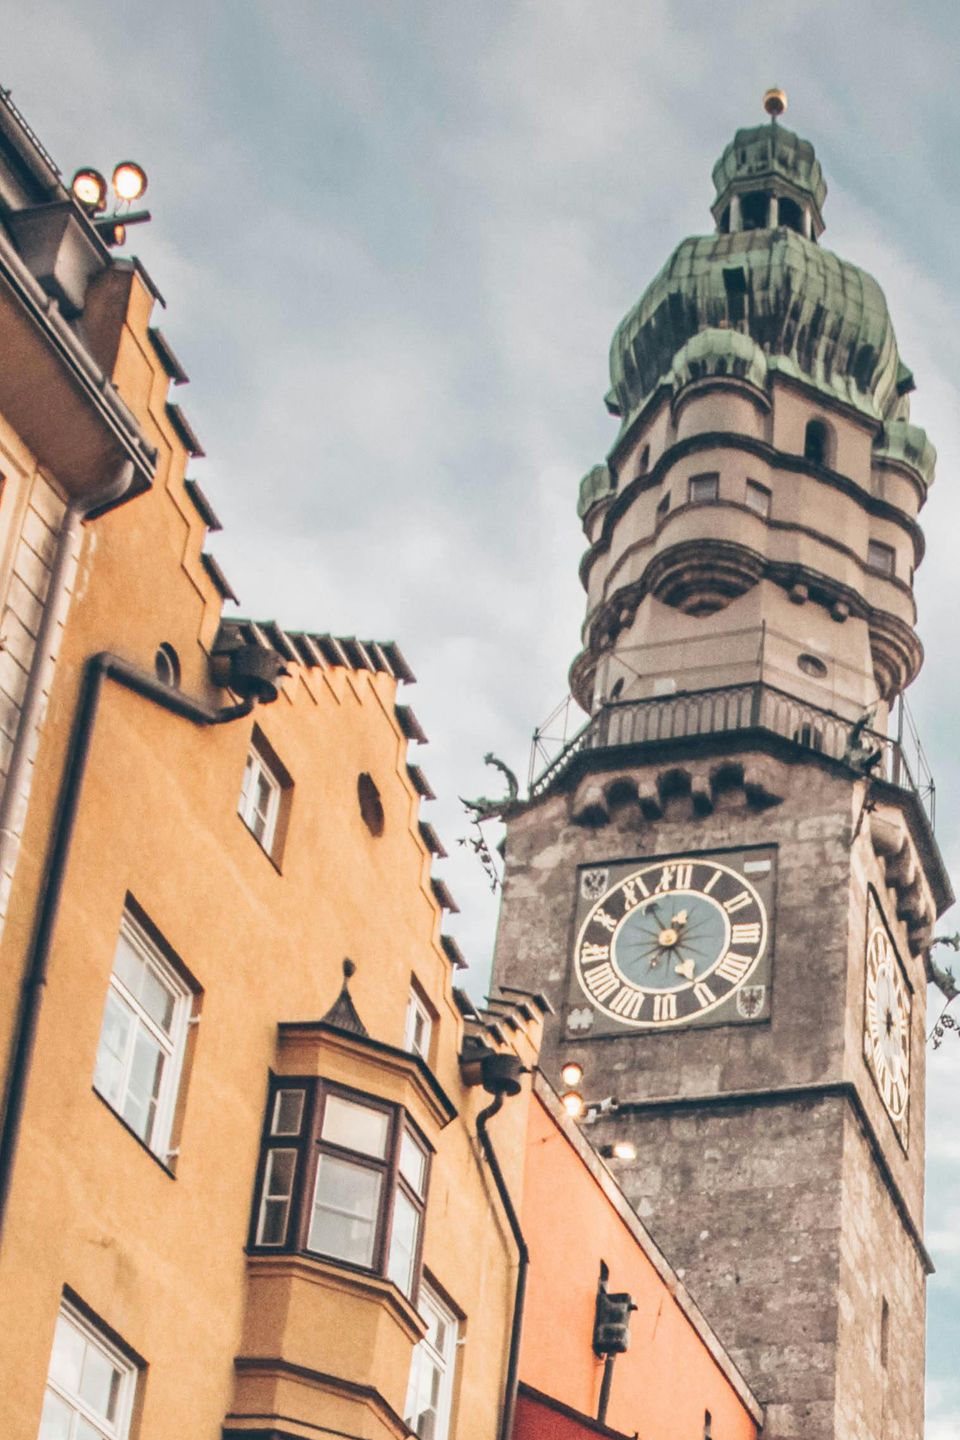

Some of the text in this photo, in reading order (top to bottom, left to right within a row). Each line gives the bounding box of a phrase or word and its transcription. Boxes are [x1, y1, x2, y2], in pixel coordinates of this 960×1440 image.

[622, 876, 650, 910] XI
[704, 870, 722, 894] I
[723, 890, 753, 914] II
[593, 908, 617, 932] X
[731, 922, 760, 944] III
